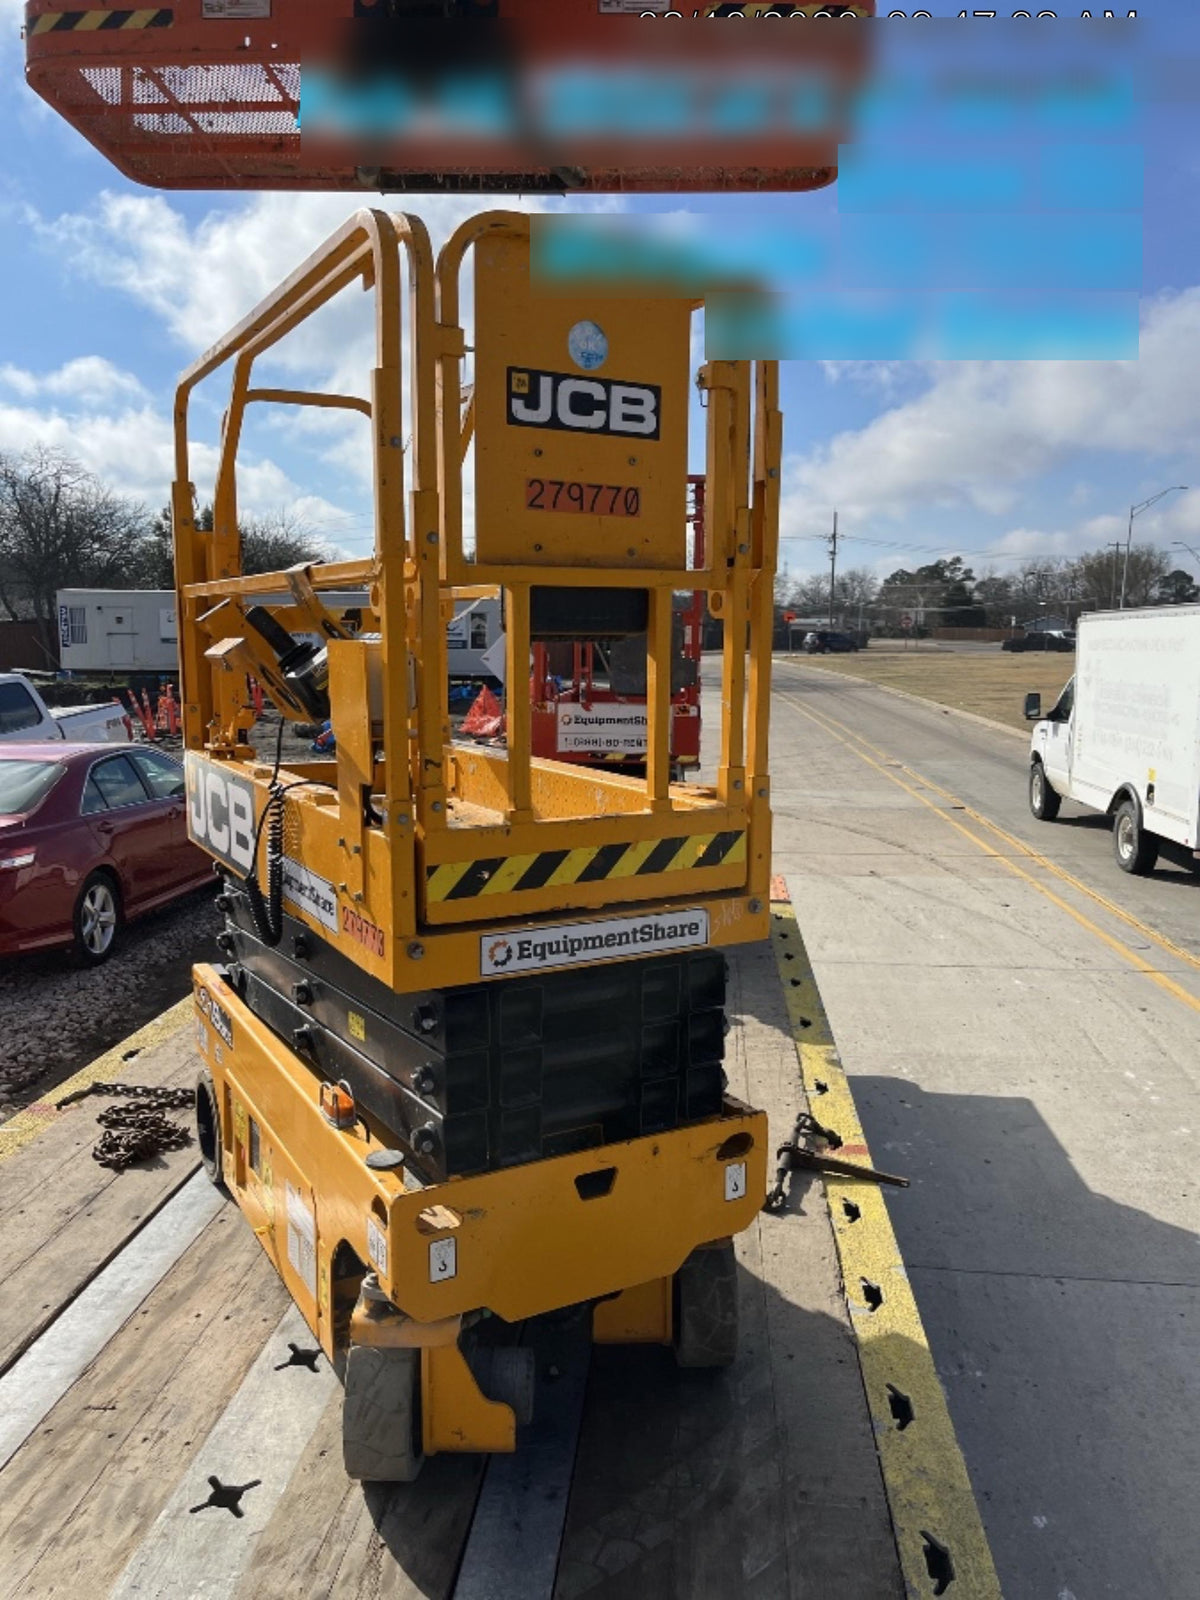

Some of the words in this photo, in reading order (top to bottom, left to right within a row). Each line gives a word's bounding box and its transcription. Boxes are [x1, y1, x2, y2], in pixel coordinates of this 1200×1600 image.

[511, 375, 657, 434] JCB
[527, 479, 640, 515] 279770
[191, 767, 256, 871] JCB
[516, 921, 700, 961] EquipmentShare
